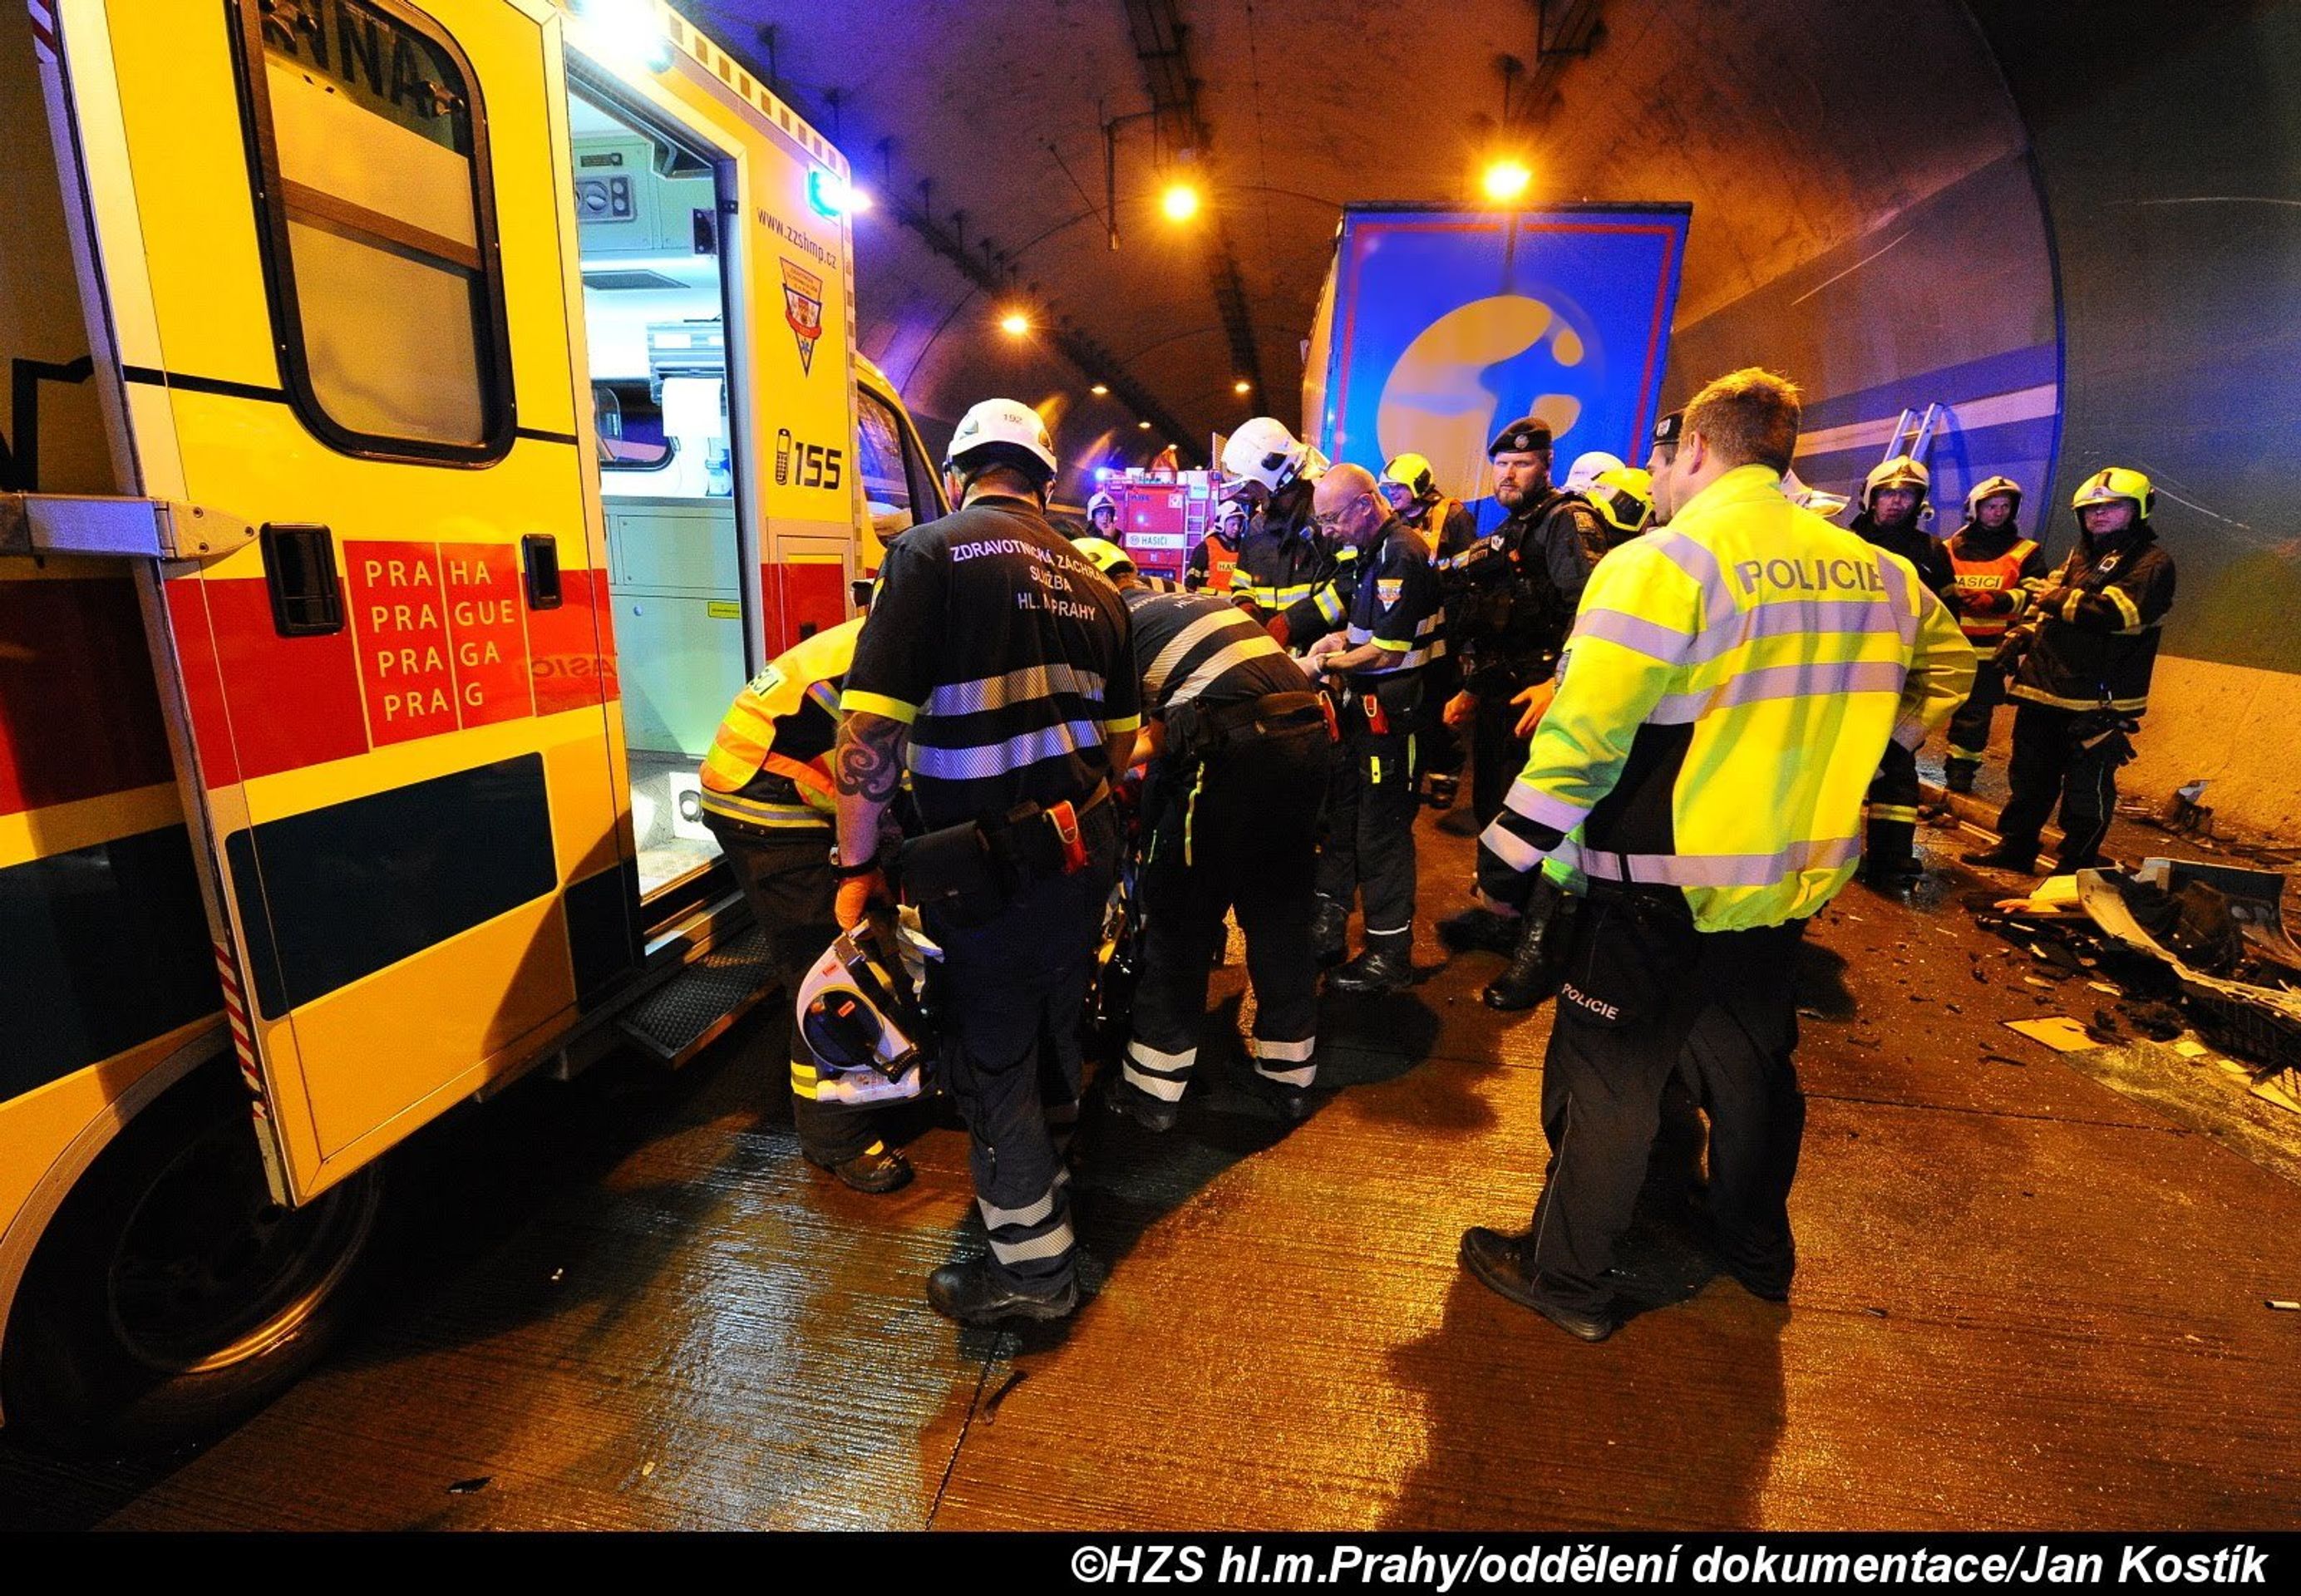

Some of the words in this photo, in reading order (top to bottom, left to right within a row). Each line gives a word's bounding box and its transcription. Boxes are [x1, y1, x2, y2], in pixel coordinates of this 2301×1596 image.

[756, 206, 836, 270] www.zzshmp.cz
[1003, 413, 1022, 425] 192
[796, 441, 842, 490] 155
[1735, 559, 1886, 595] POLICIE
[1017, 592, 1040, 610] HL.
[1051, 600, 1096, 621] PRAHY
[1561, 983, 1620, 1021] POLICIE
